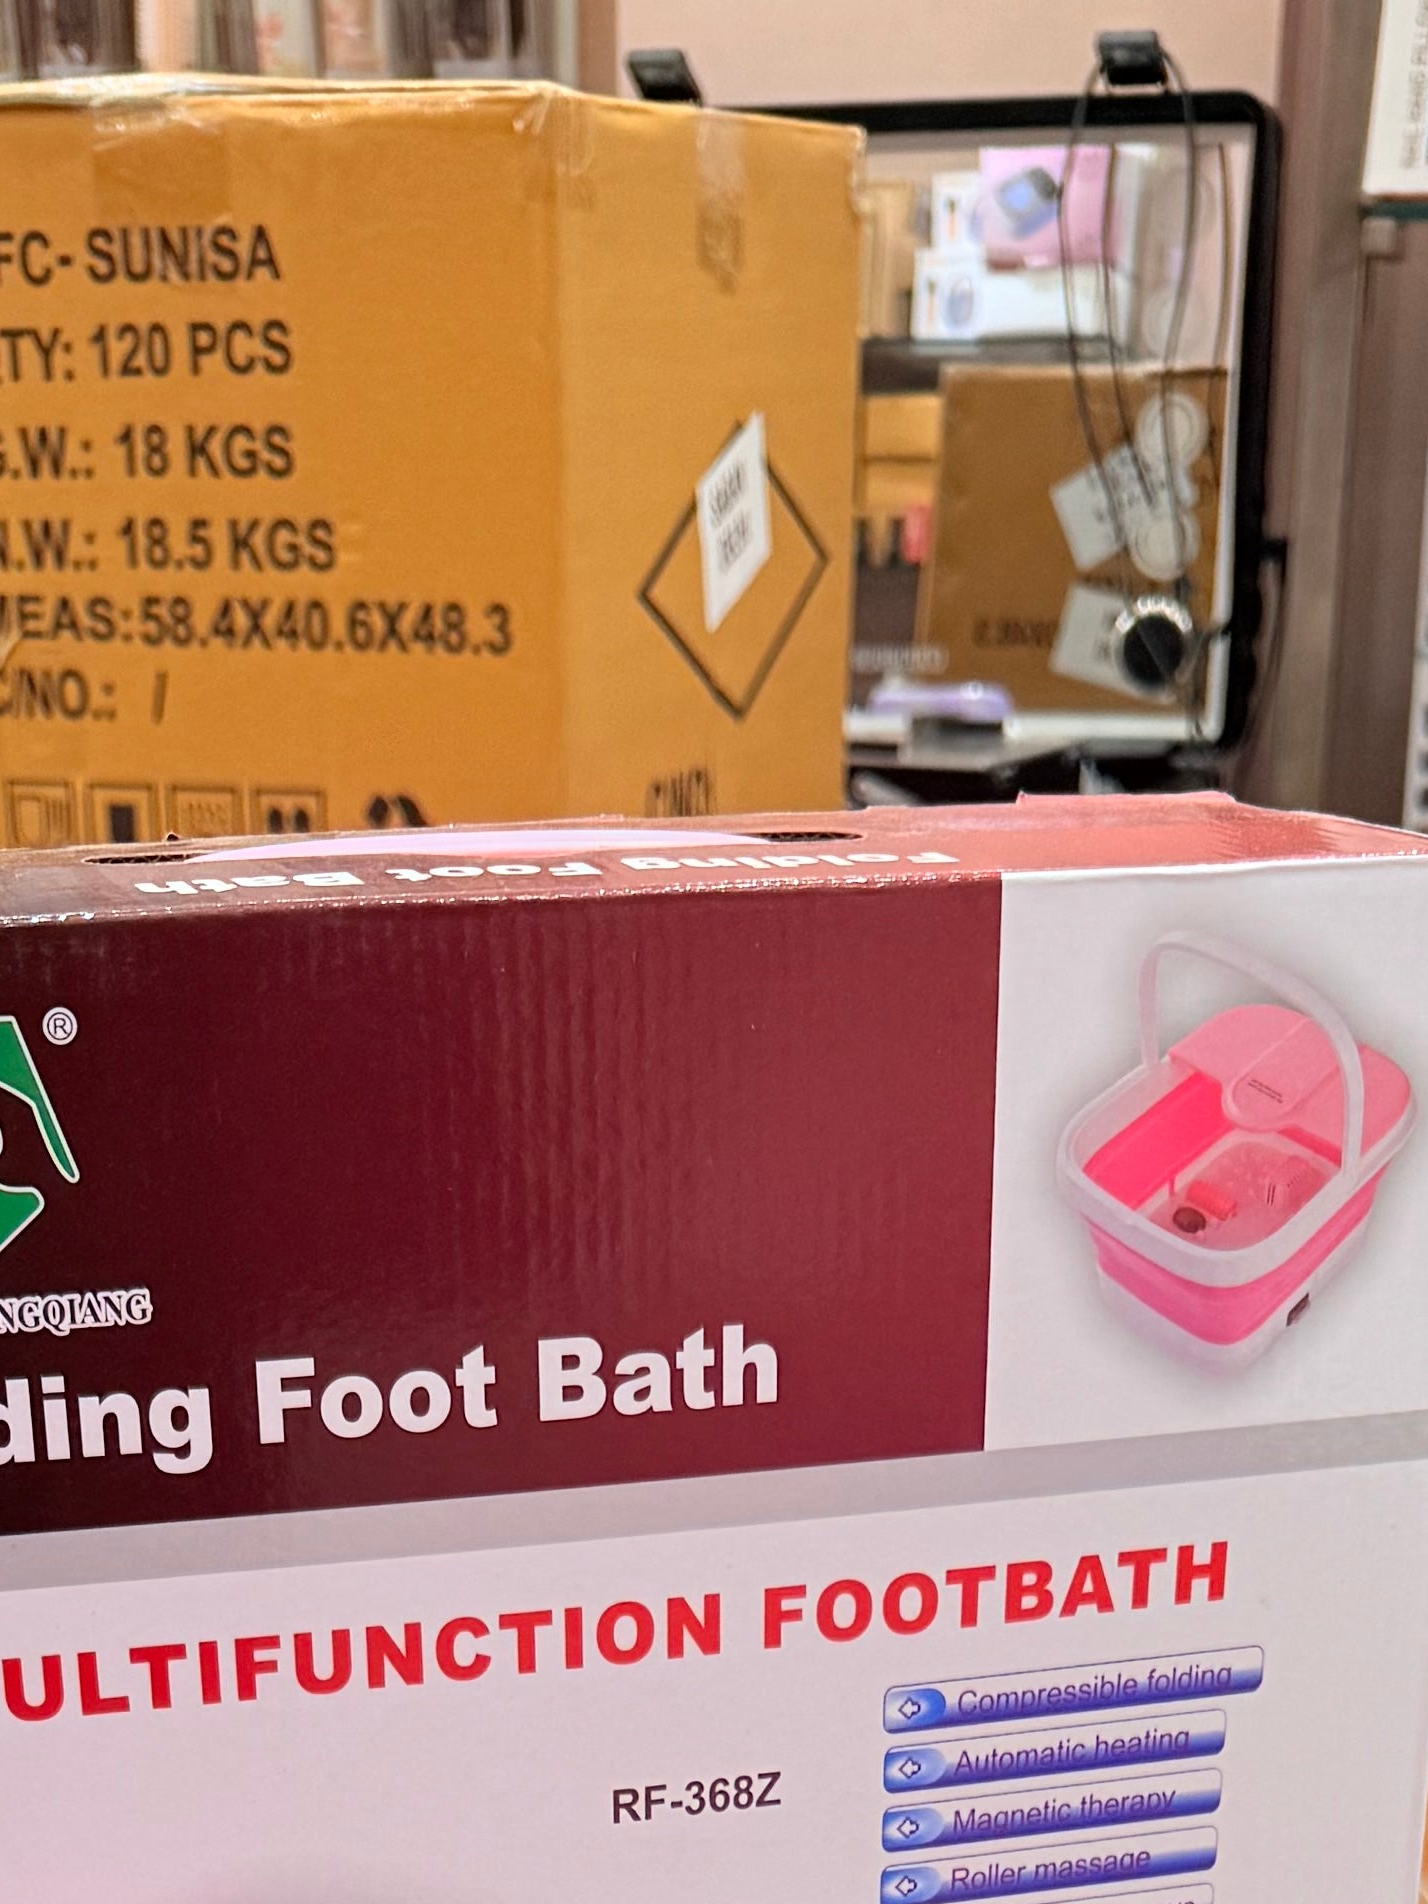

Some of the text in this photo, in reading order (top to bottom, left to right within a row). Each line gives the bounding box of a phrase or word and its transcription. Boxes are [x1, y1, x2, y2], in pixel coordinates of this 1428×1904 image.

[85, 223, 281, 284] SUNISA
[89, 322, 172, 380] 120
[189, 319, 293, 376] PCS
[116, 424, 171, 478] 18
[187, 422, 296, 479] KGS
[117, 518, 214, 572] 18.5
[228, 516, 337, 573] KGS
[134, 849, 961, 896] Folding Foot Bath
[255, 1345, 499, 1446] Foot
[539, 1323, 779, 1423] Bath
[762, 1540, 1230, 1650] FOOTBATH
[957, 1663, 1233, 1718] Compressible folding
[953, 1726, 1192, 1778] Automatic heating
[611, 1770, 783, 1824] RF-368Z
[952, 1788, 1178, 1838] Magnetic therapy
[949, 1848, 1152, 1893] Roller massage
